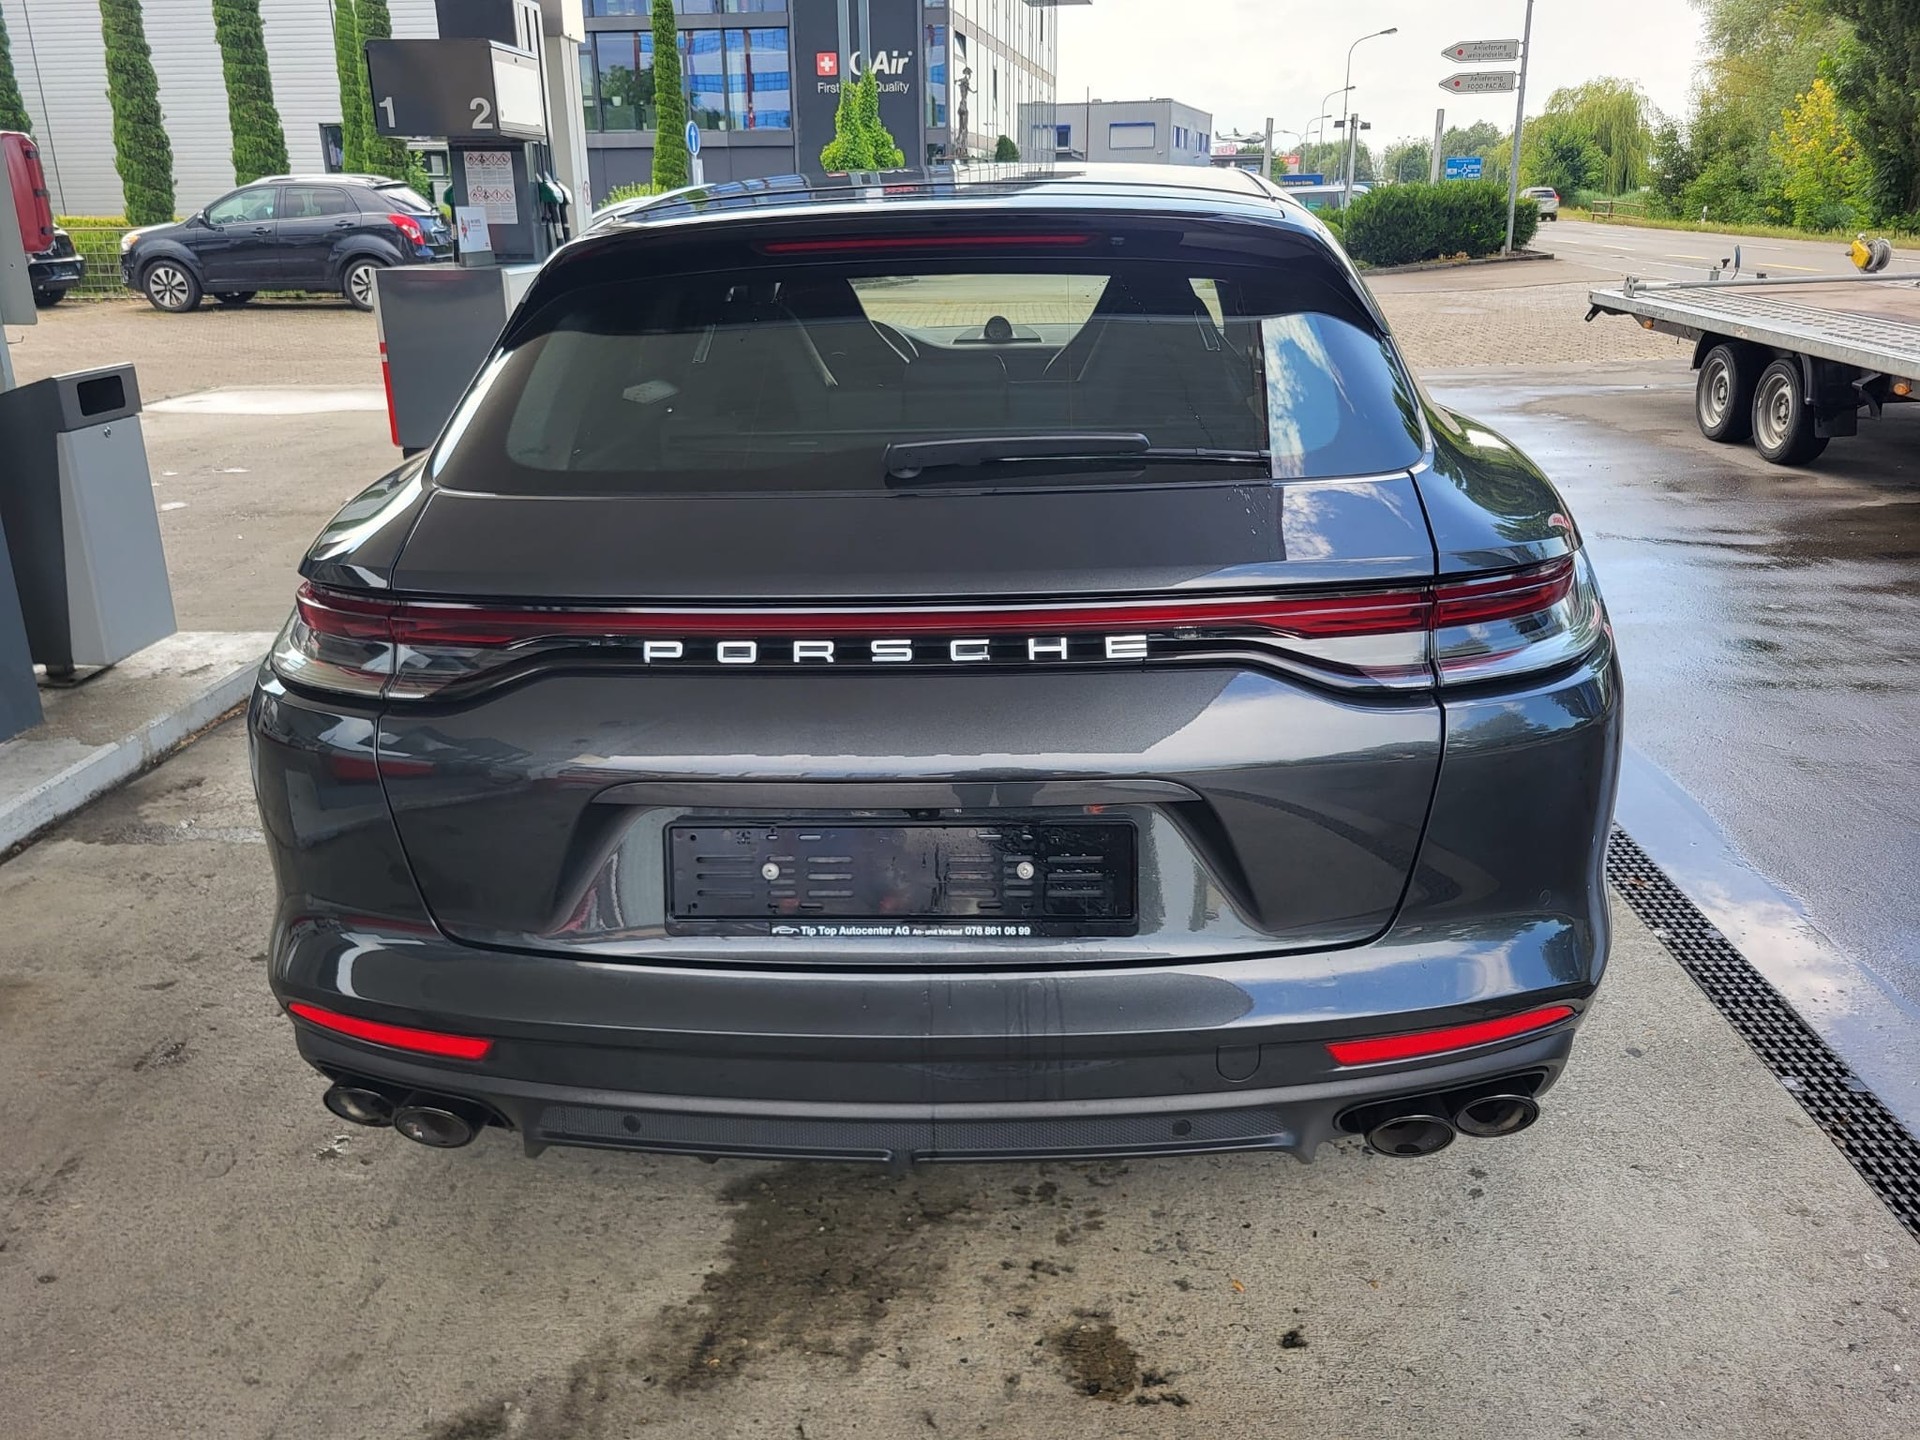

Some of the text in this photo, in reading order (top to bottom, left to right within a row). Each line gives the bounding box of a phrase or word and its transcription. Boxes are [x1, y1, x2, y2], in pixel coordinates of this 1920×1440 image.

[817, 81, 910, 94] First Quality
[379, 96, 396, 128] 1
[469, 97, 493, 129] 2
[643, 635, 1148, 663] PORSCHE
[800, 926, 817, 937] Tip
[818, 926, 837, 937] Top
[839, 926, 893, 935] Autocenter
[894, 926, 910, 935] AG
[984, 926, 1002, 935] 861
[1004, 926, 1016, 935] 06
[1018, 926, 1031, 935] 99
